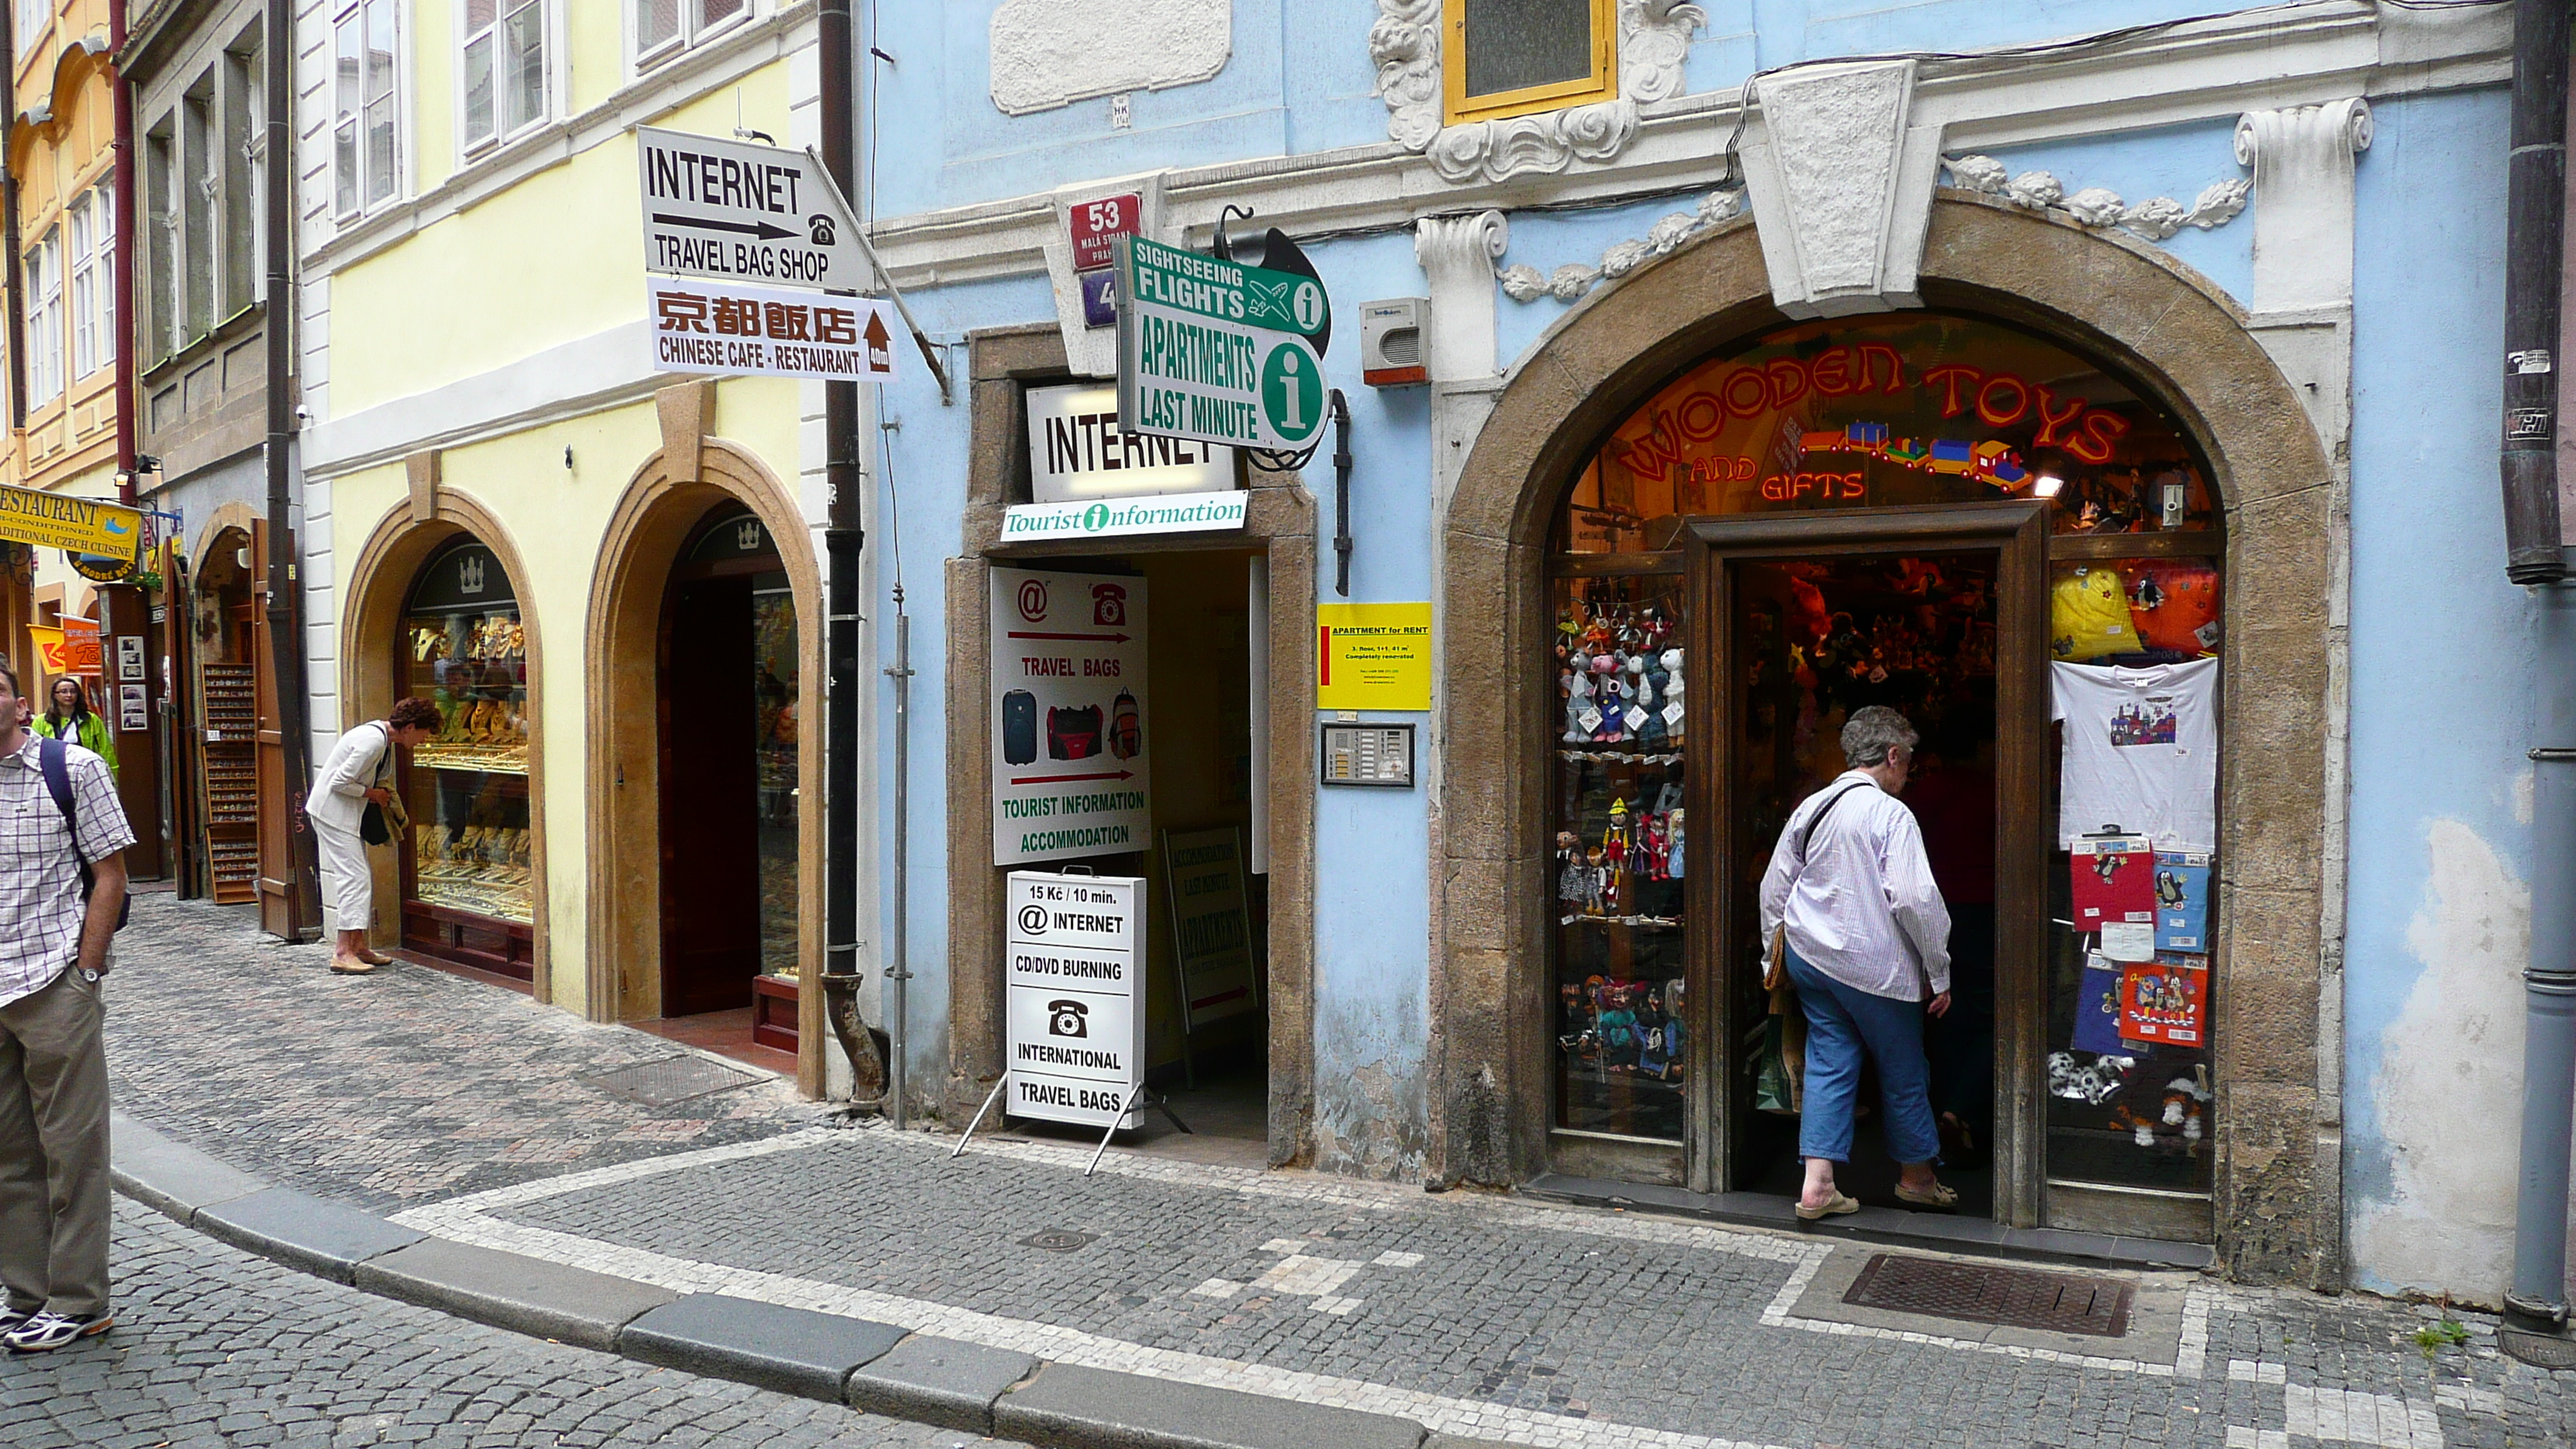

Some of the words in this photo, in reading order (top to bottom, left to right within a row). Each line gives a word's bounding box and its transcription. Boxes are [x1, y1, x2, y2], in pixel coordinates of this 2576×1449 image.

[646, 146, 801, 214] INTERNET
[1088, 201, 1120, 231] 53
[1081, 233, 1101, 249] MALÁ
[655, 234, 731, 272] TRAVEL
[735, 244, 774, 277] BAG
[779, 248, 828, 282] SHOP
[1092, 249, 1112, 262] PRAH
[1136, 243, 1243, 287] SIGHTSEEING
[1100, 282, 1115, 310] 4
[1138, 268, 1244, 318] FLIGHTS
[656, 291, 857, 345] 京都飯店
[659, 337, 724, 366] CHINESE
[728, 342, 764, 368] CAFE
[776, 345, 859, 375] RESTAURANT
[870, 351, 889, 365] 40m
[1141, 314, 1256, 393] APARTMENTS
[1140, 386, 1185, 430] LAST
[1192, 395, 1258, 440] MINUTE
[1619, 342, 1906, 481] WOODEN
[1923, 364, 2129, 464] TOYS
[1688, 454, 1757, 483] AND
[1762, 471, 1865, 501] GIFTS
[0, 488, 98, 526] ESTAURANT
[0, 515, 94, 536] R-CONDITIONED
[1006, 512, 1082, 533] Tourist
[55, 536, 87, 551] CZECH
[91, 543, 131, 557] CUISINE
[1022, 658, 1075, 677] TRAVEL
[1084, 659, 1121, 677] BAGS
[1002, 796, 1058, 819] TOURIST
[1062, 791, 1144, 815] INFORMATION
[1021, 825, 1129, 852] ACCOMMODATION
[1173, 842, 1235, 868] ACCOMMODATION
[1029, 886, 1043, 899] 15
[1047, 886, 1063, 900] Kč
[1073, 888, 1088, 903] 10
[1091, 890, 1117, 904] min.
[1053, 912, 1122, 933] INTERNET
[1016, 955, 1059, 975] CD/DVD
[1063, 961, 1122, 980] BURNING
[1018, 1043, 1121, 1070] INTERNATIONAL
[1020, 1082, 1075, 1107] TRAVEL
[1080, 1089, 1120, 1112] BAGS
